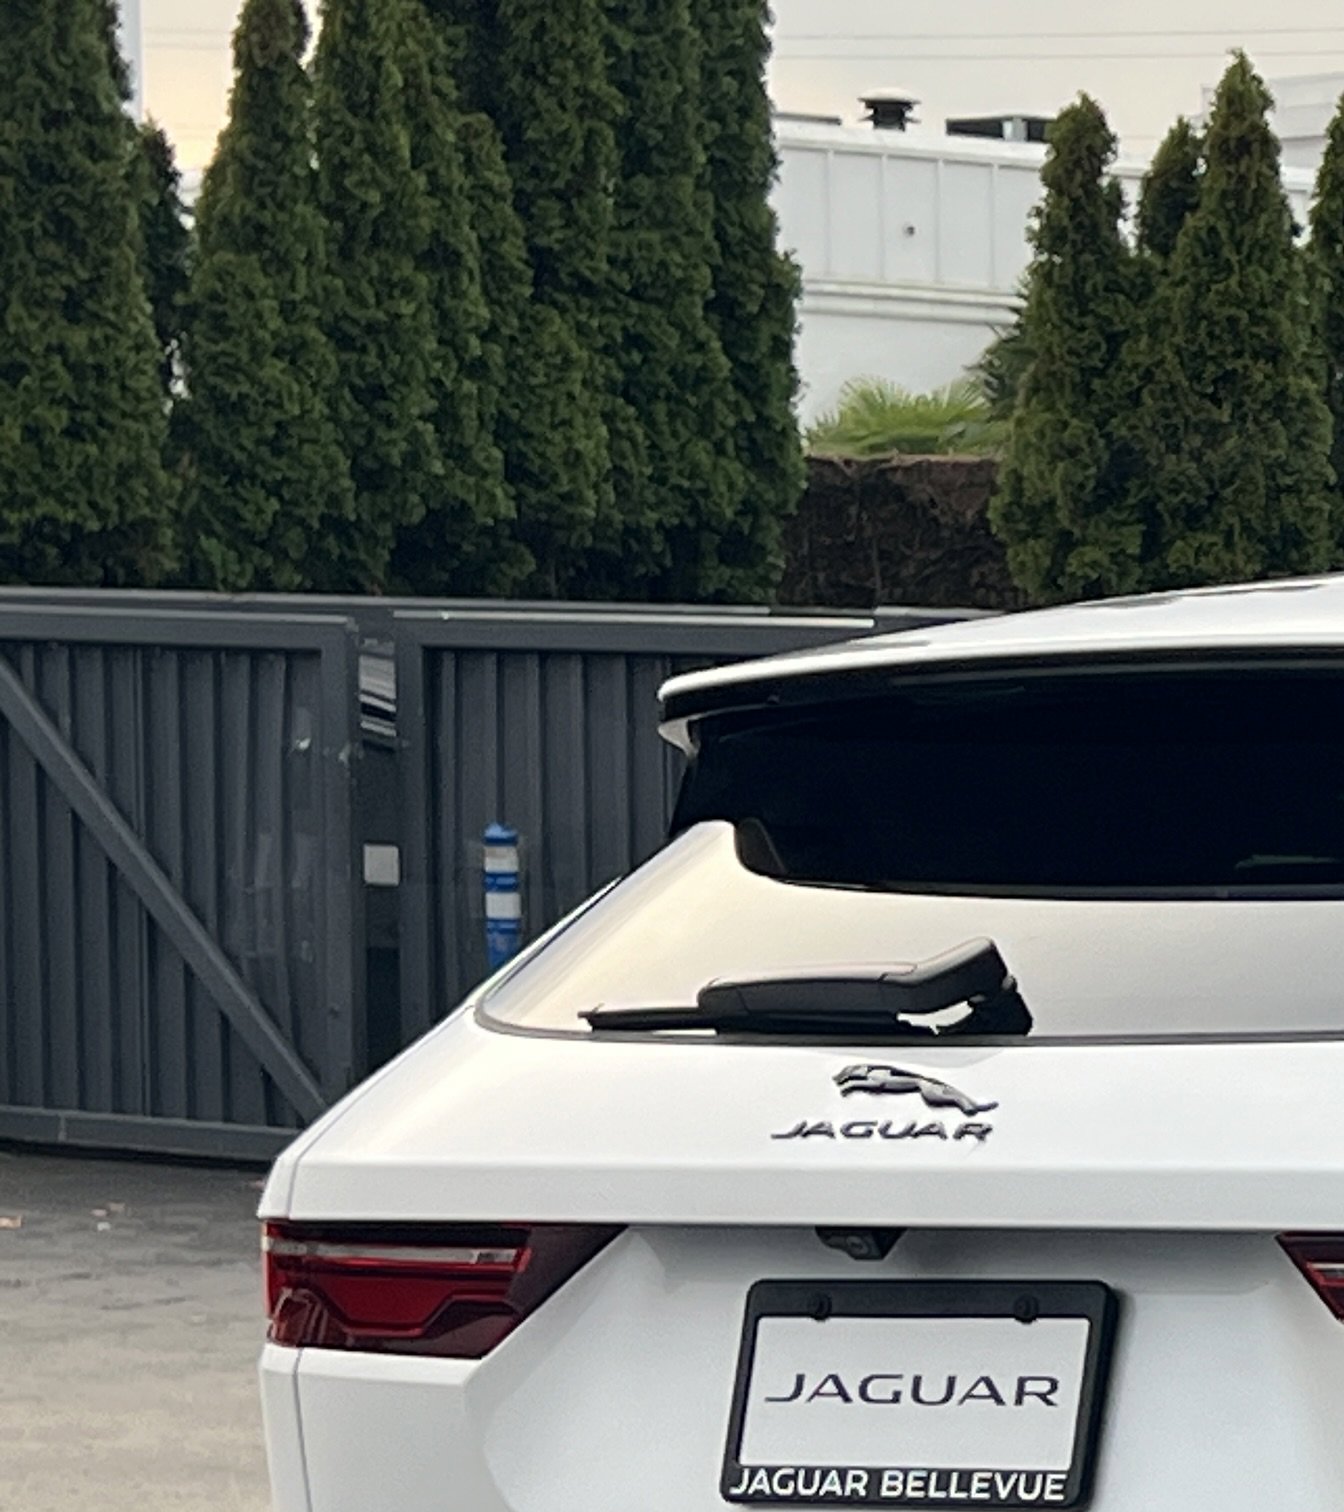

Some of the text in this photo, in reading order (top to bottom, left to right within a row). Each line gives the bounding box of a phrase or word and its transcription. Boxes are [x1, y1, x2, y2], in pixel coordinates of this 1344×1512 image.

[771, 1120, 993, 1141] JAGUAR
[765, 1373, 1059, 1406] JAGUAR
[729, 1467, 1067, 1501] JAGUAR BELLEVUE
